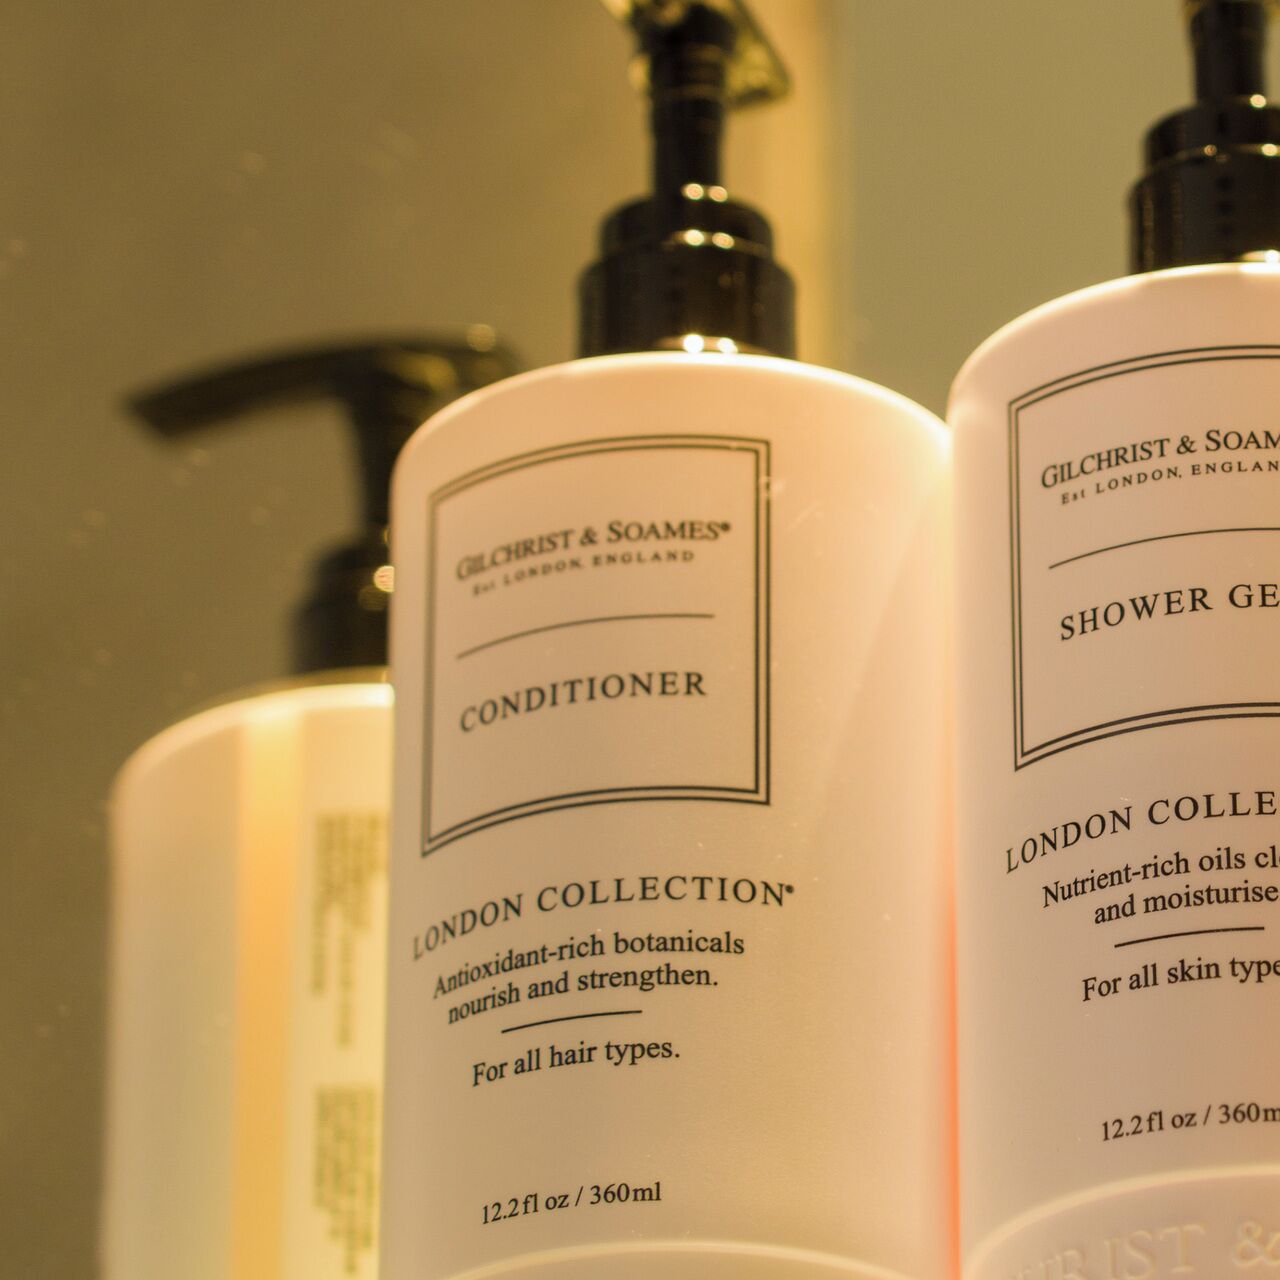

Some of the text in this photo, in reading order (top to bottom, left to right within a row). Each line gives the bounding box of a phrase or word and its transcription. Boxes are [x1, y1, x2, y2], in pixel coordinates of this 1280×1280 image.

[1040, 437, 1171, 490] GILCHRIST
[1175, 434, 1198, 456] &
[1061, 488, 1087, 506] Est
[1095, 466, 1183, 495] LONDON,
[456, 528, 576, 581] GILCHRIST
[579, 526, 598, 547] &
[593, 547, 696, 568] ENGLAND
[1059, 586, 1213, 642] SHOWER
[459, 670, 708, 733] CONDITIONER
[1004, 805, 1133, 874] LONDON
[1041, 851, 1191, 909] Nutrient-rich
[1197, 846, 1247, 872] oils
[411, 892, 524, 962] LONDON
[1093, 894, 1136, 925] and
[432, 930, 746, 1000] Antioxidant-rich botanicals
[1081, 975, 1122, 1002] For
[1128, 963, 1159, 991] all
[1166, 957, 1222, 984] skin
[447, 963, 720, 1025] nourish and strengthen.
[471, 1038, 681, 1088] For all hair types.
[1170, 1109, 1198, 1130] oz
[1202, 1105, 1213, 1127] /
[544, 1190, 570, 1212] oz
[574, 1187, 584, 1208] /
